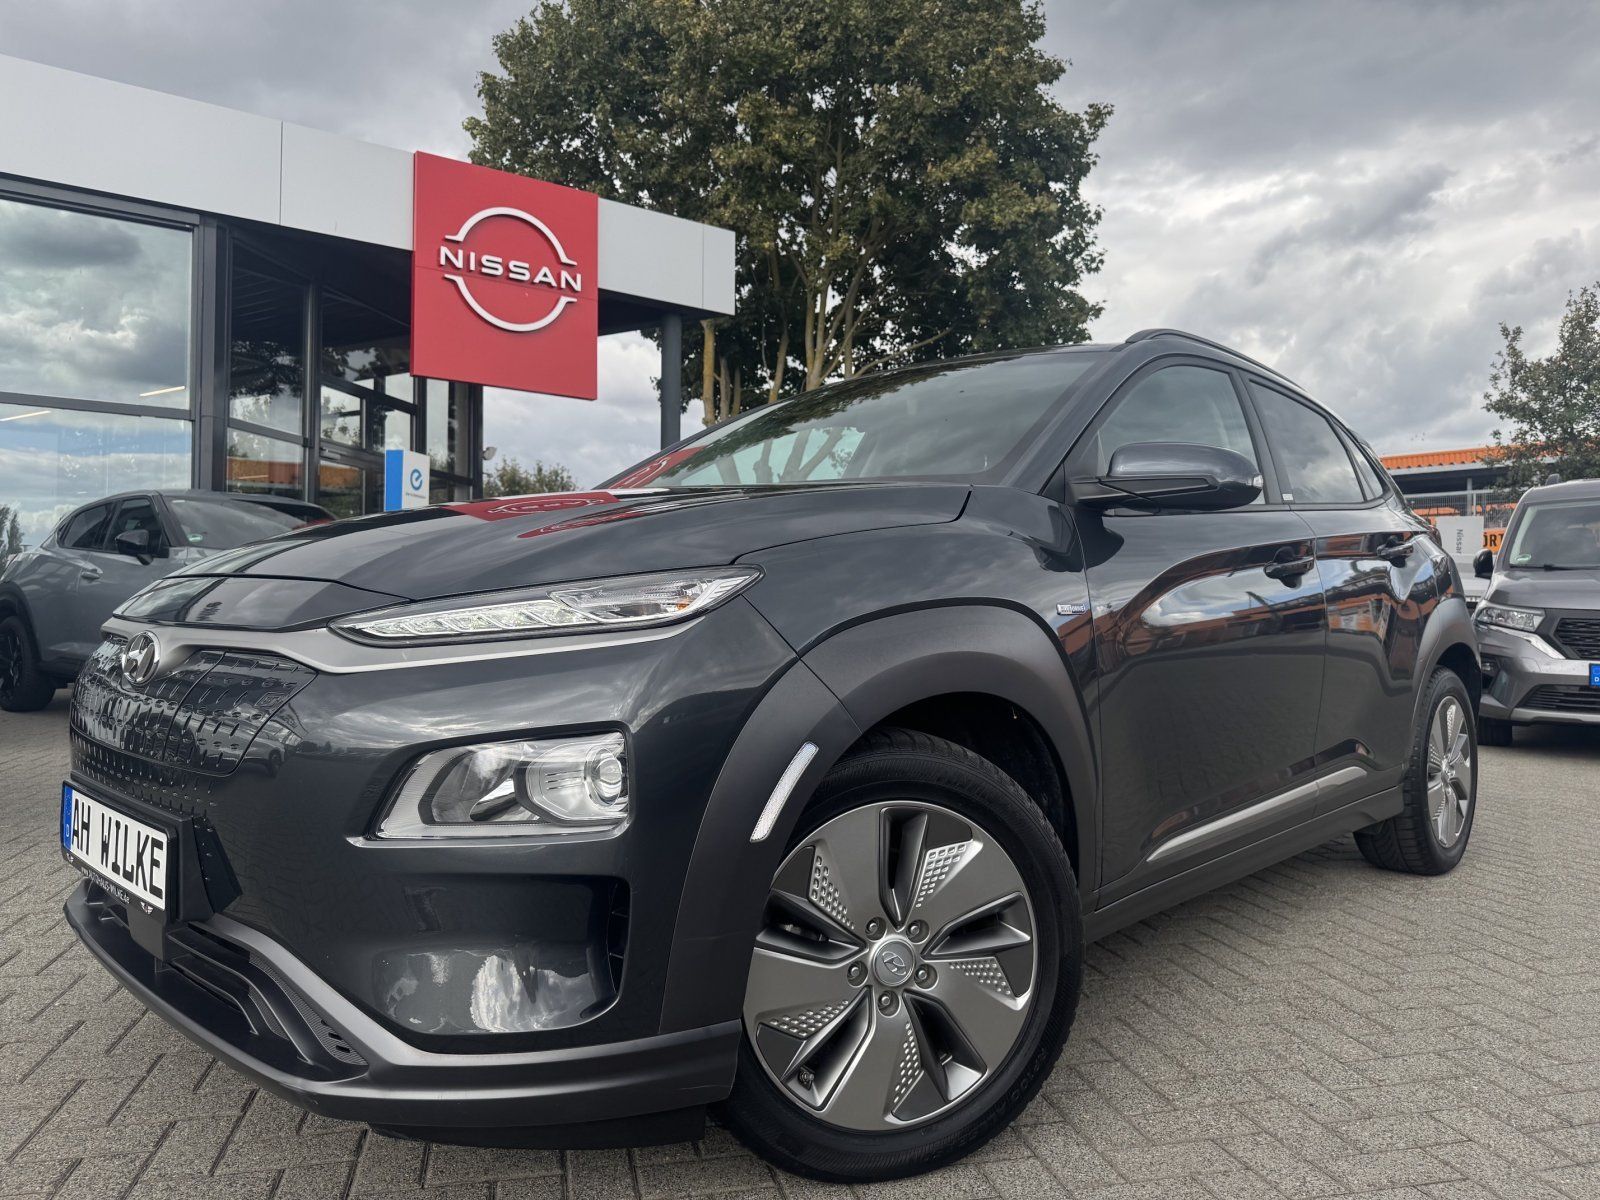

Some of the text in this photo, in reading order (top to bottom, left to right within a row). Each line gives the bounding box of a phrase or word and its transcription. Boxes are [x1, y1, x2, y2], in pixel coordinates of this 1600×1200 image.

[439, 245, 582, 292] NISSAN
[72, 798, 164, 900] AH WILKE
